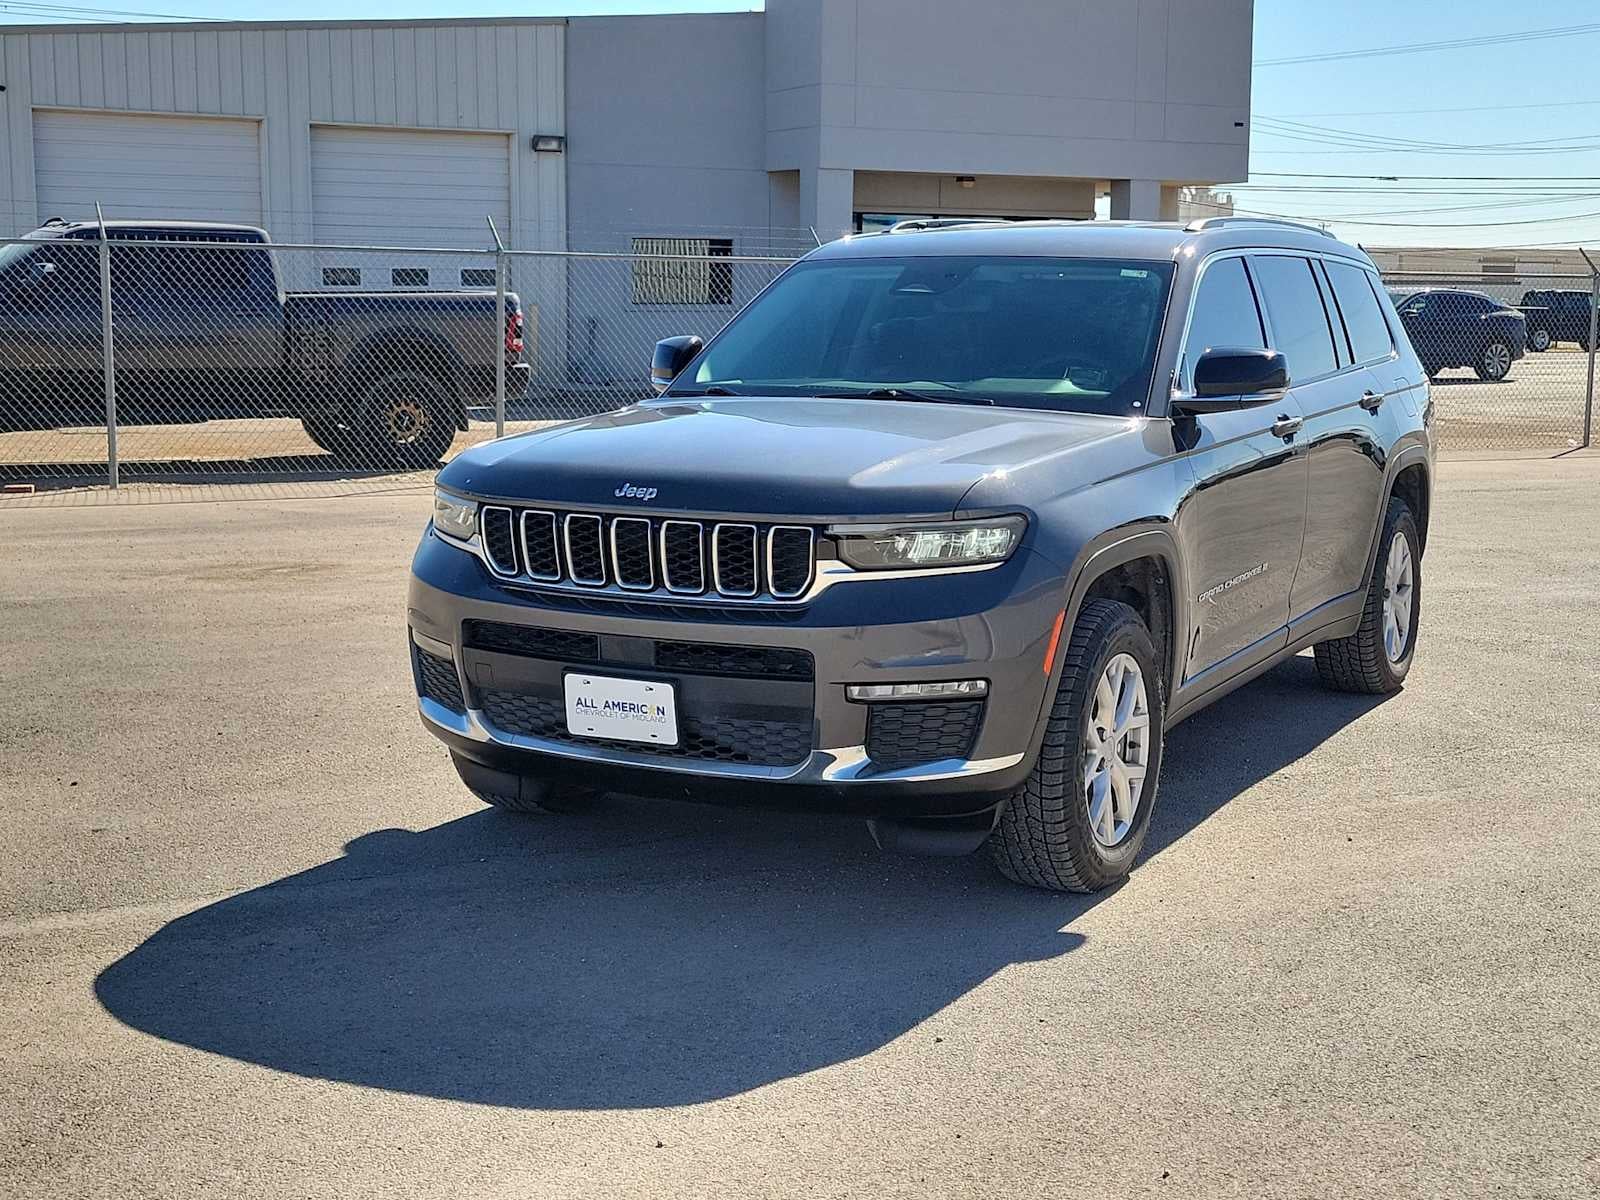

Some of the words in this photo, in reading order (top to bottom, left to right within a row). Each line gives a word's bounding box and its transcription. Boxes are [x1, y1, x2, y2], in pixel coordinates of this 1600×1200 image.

[614, 482, 658, 501] Jeep
[1198, 583, 1224, 602] GRAND
[1224, 565, 1262, 588] CHEROKEE
[576, 697, 598, 709] ALL
[603, 700, 665, 716] AMERICAN
[576, 707, 618, 718] CHEVROLET
[632, 714, 666, 723] MIDLAND
